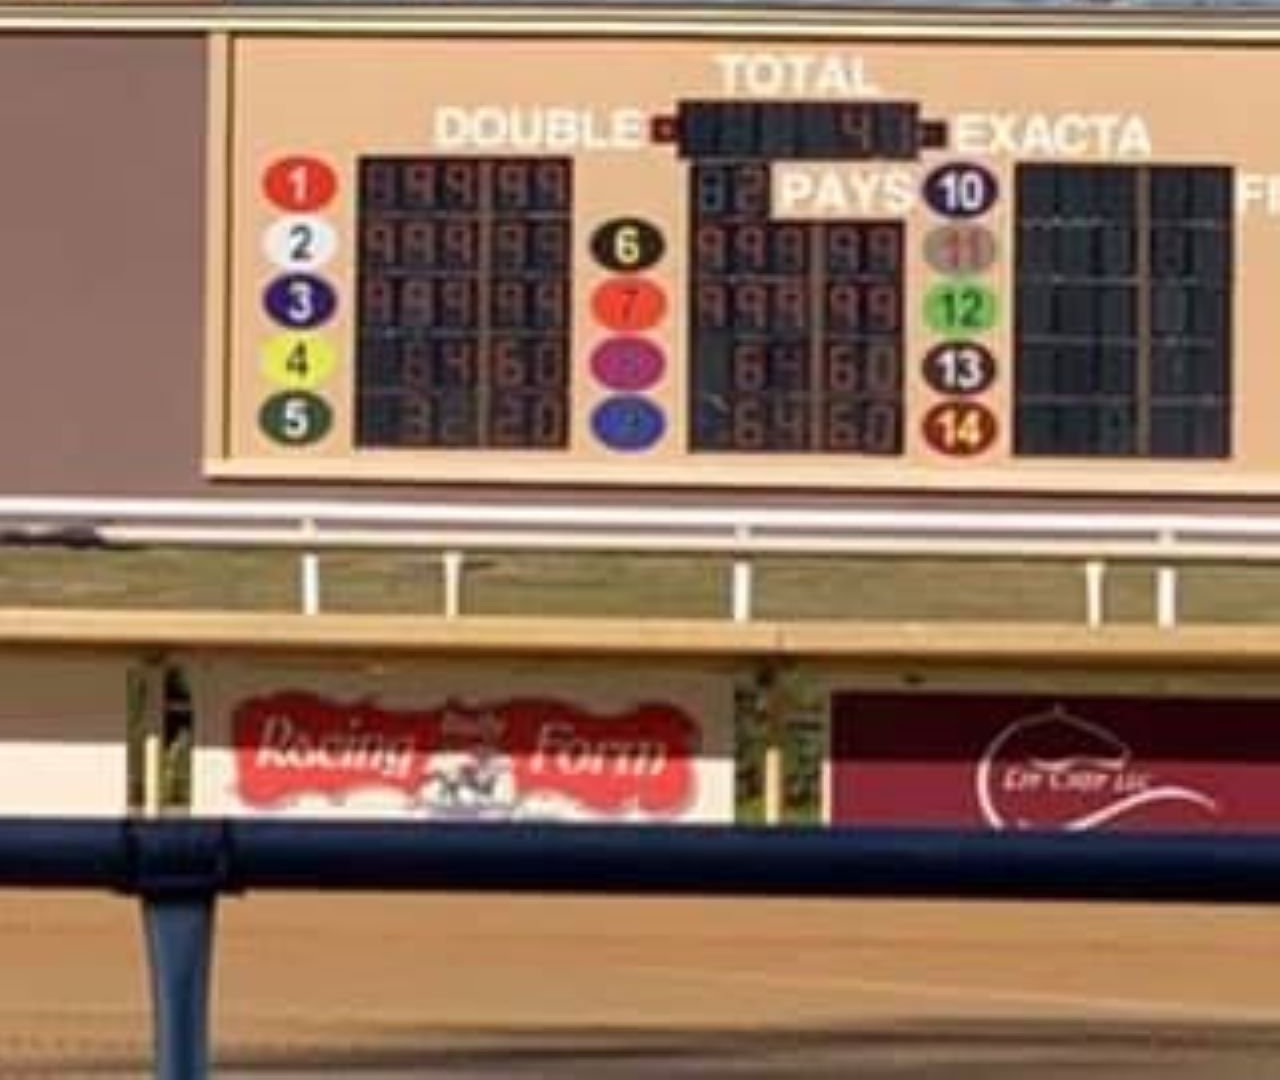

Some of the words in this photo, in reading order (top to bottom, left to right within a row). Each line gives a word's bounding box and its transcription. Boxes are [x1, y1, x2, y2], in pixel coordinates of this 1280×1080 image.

[714, 54, 880, 94] TOTAL
[434, 107, 642, 150] DOUBLE
[952, 114, 1152, 156] EXACTA
[289, 165, 309, 204] 1
[781, 170, 917, 214] PAYS
[936, 172, 984, 210] 10
[289, 223, 313, 261] 2
[614, 225, 641, 264] 6
[289, 281, 313, 322] 3
[621, 288, 640, 320] 7
[940, 287, 984, 327] 12
[285, 340, 309, 379] 4
[936, 350, 982, 390] 13
[284, 398, 309, 438] 5
[937, 408, 981, 448] 14
[253, 712, 416, 778] Racing
[530, 721, 669, 777] Form
